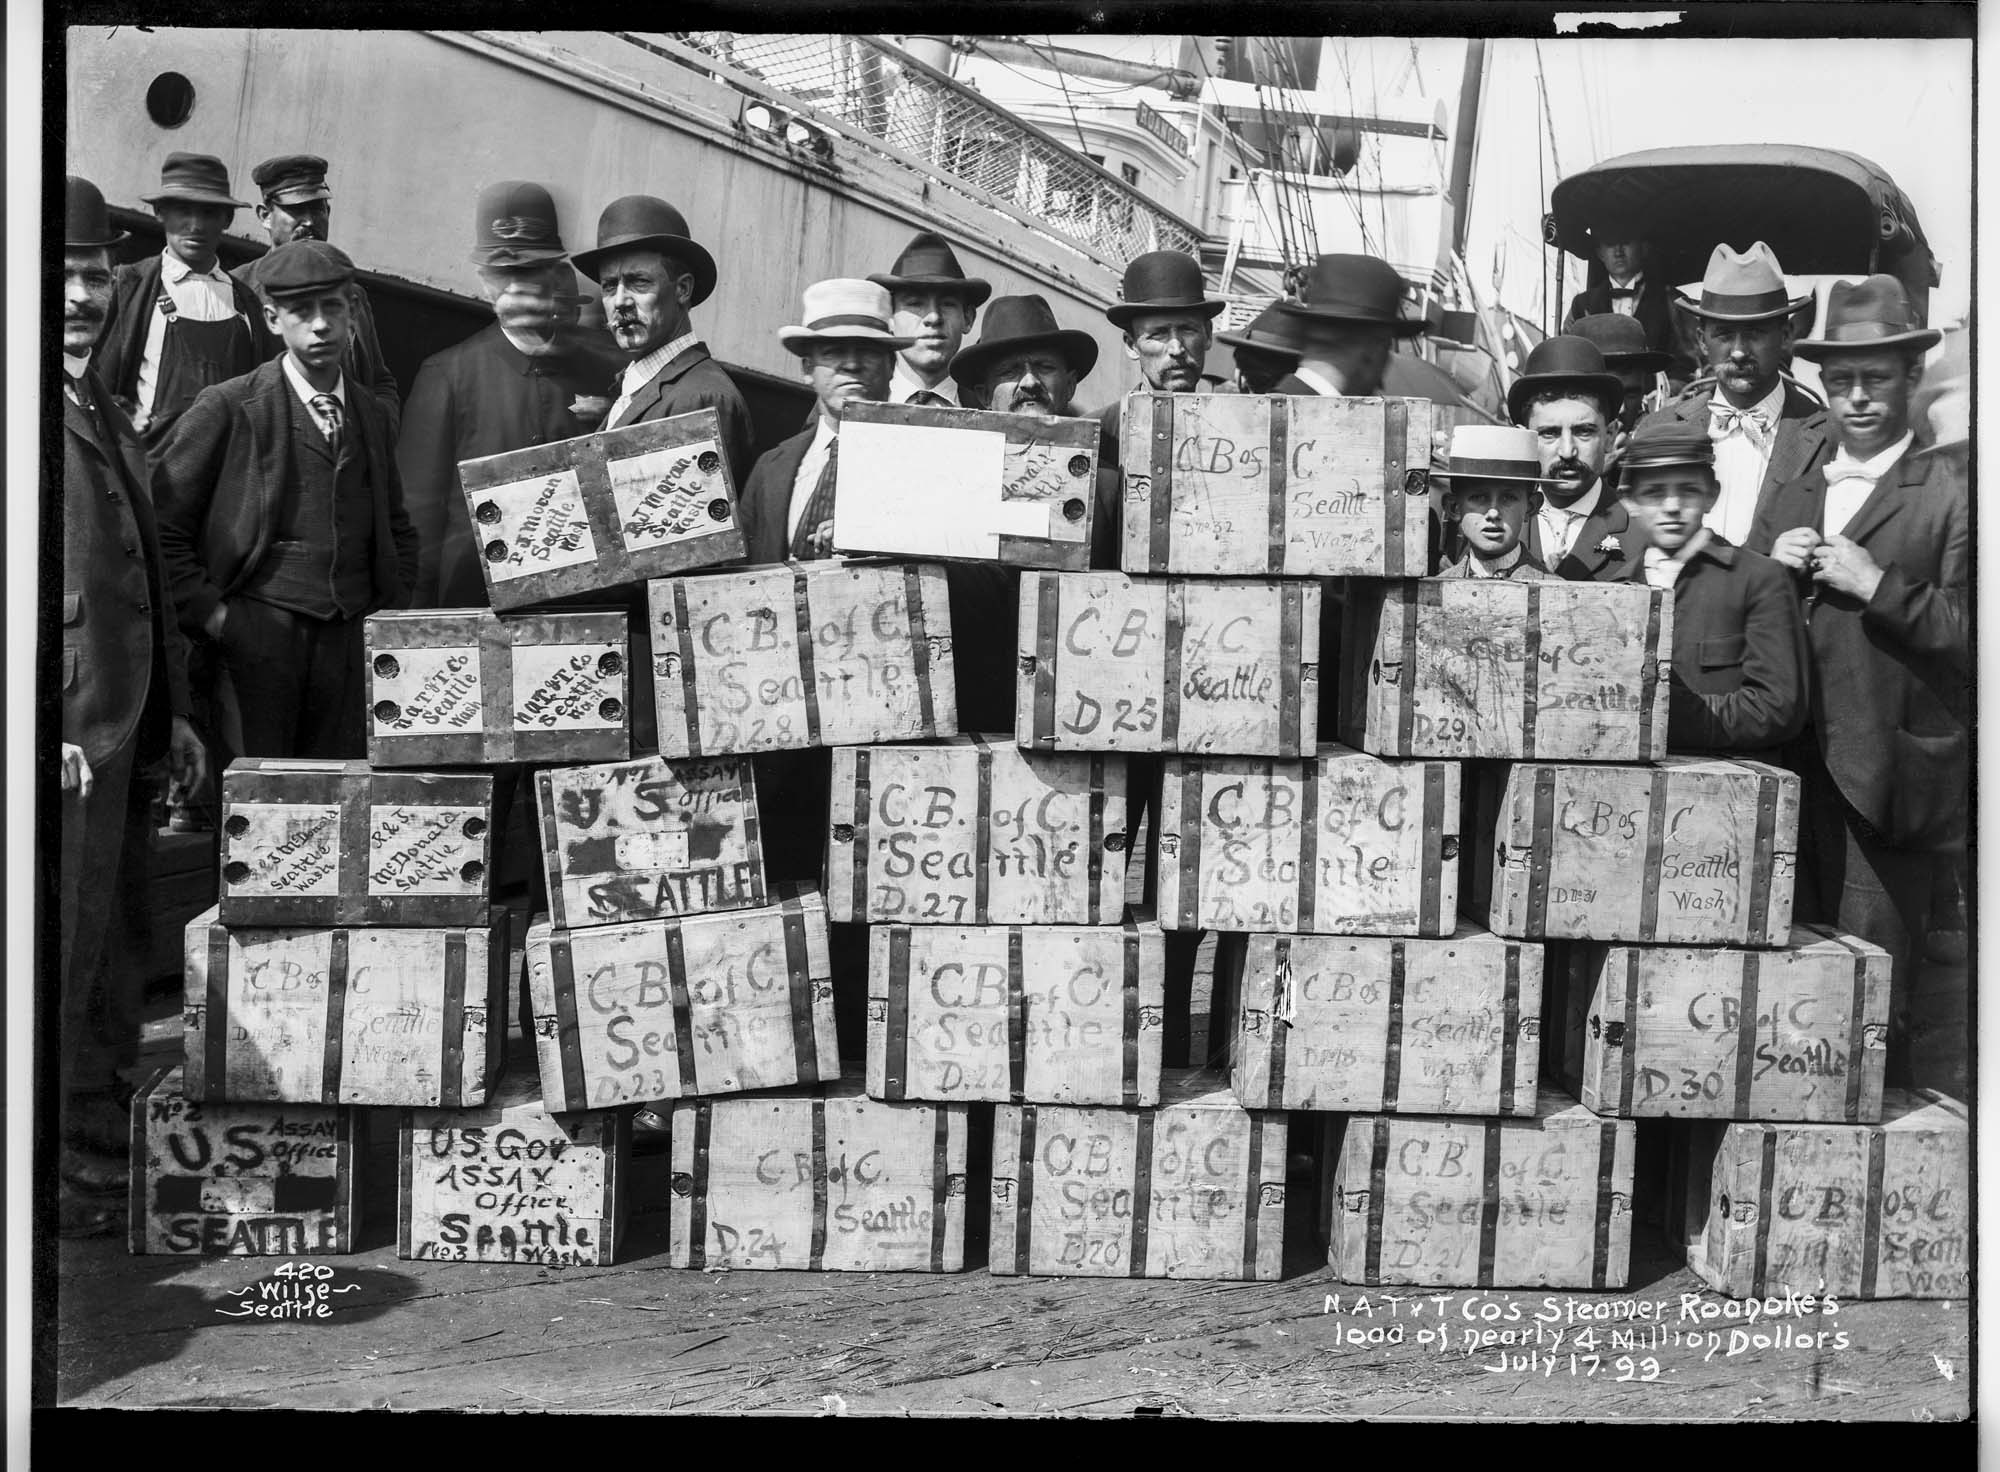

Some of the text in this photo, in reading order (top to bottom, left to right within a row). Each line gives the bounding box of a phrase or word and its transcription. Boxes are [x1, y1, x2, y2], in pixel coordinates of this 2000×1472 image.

[819, 605, 857, 661] of
[422, 673, 478, 725] Seattle
[718, 654, 901, 714] Seattle
[1183, 662, 1273, 703] Seattle
[993, 798, 1031, 843] of
[1324, 800, 1361, 845] of
[396, 844, 460, 892] Seattle
[885, 832, 1076, 880] Seattle
[1663, 846, 1740, 879] Seattle
[1667, 889, 1725, 911] Wash
[1754, 1038, 1847, 1081] Seattle
[267, 1115, 337, 1138] ASSAY
[268, 1142, 337, 1165] Office
[435, 1164, 553, 1193] ASSAY
[834, 1196, 932, 1233] Seattle
